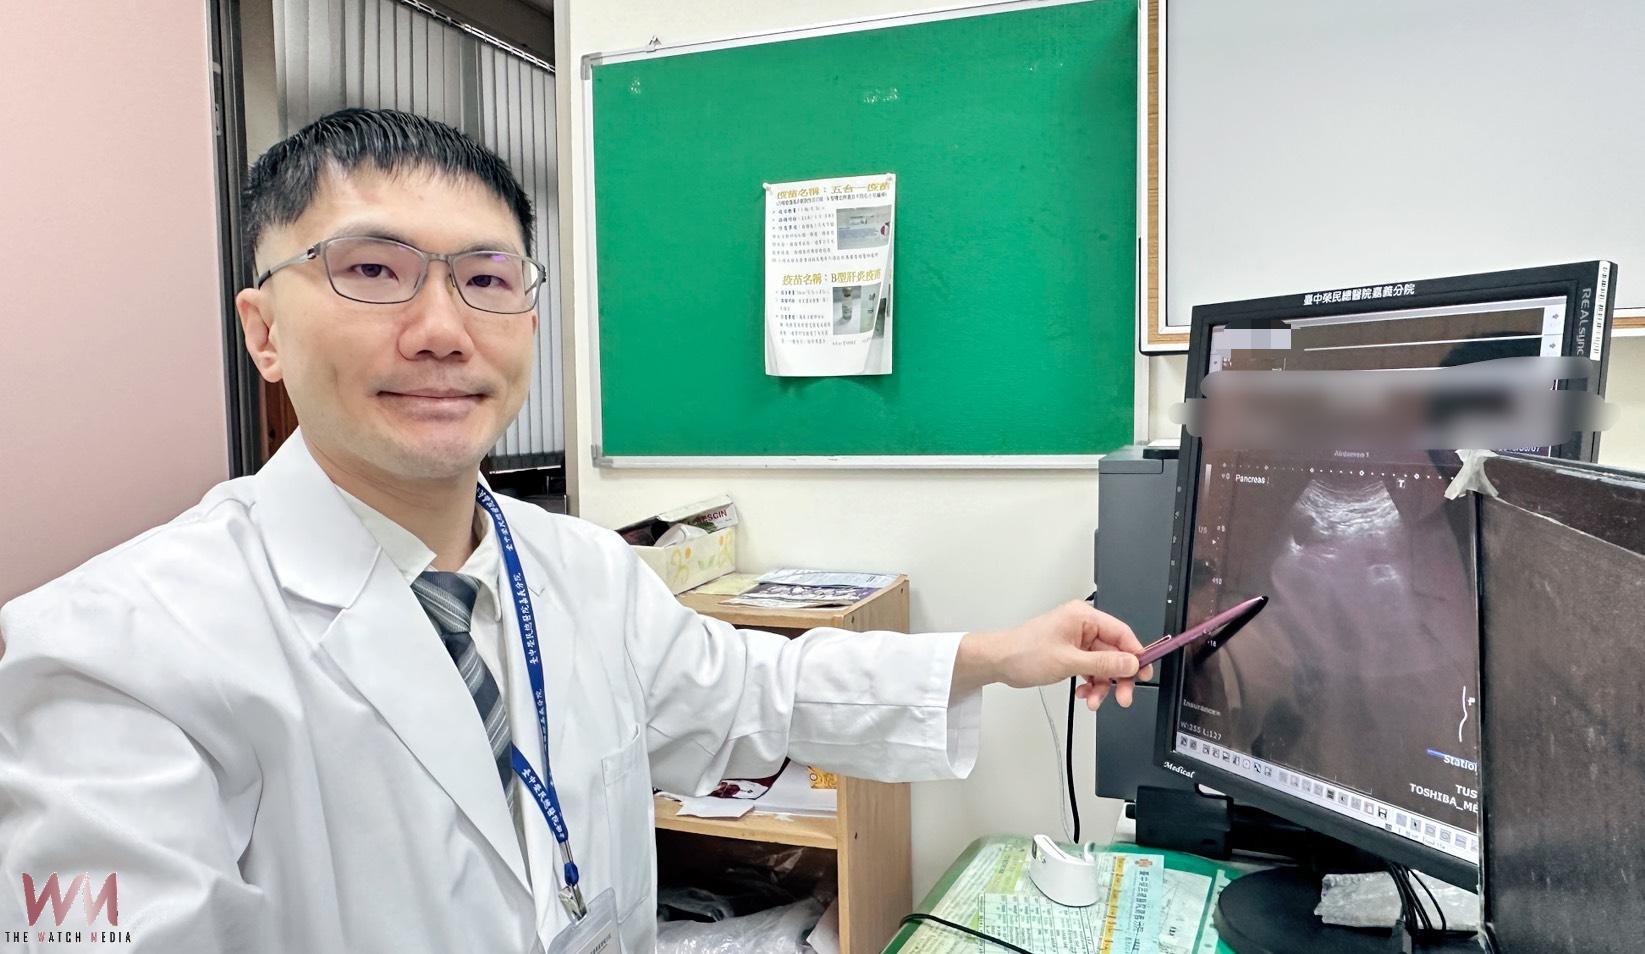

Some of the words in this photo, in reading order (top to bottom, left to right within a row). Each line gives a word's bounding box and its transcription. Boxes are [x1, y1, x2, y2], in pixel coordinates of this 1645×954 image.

[1303, 283, 1416, 306] 臺中榮民總醫院嘉義分院
[1163, 760, 1196, 779] Medical
